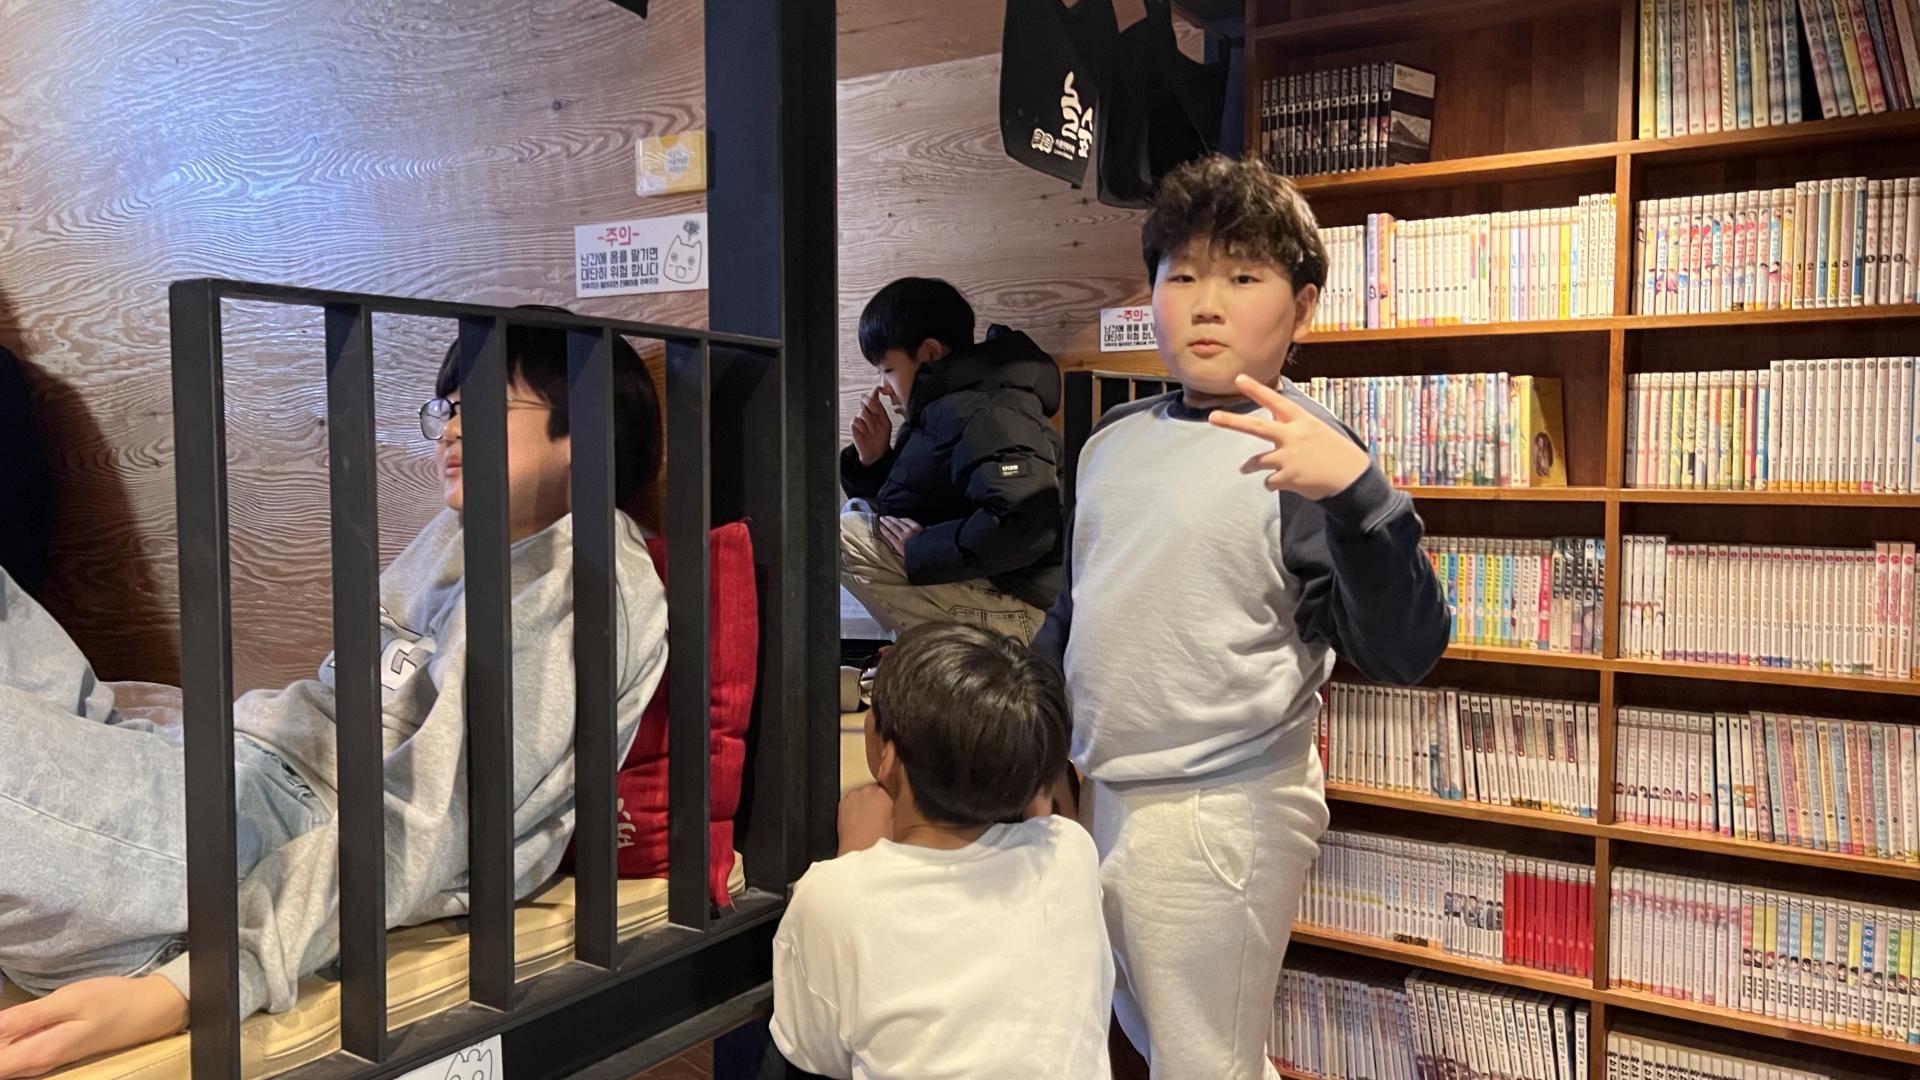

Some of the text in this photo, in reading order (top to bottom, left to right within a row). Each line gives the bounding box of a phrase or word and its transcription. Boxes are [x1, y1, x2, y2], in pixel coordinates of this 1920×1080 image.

[580, 252, 607, 268] 난간에
[610, 249, 628, 264] 몸을
[580, 262, 659, 281] 대단히 위험 합니다
